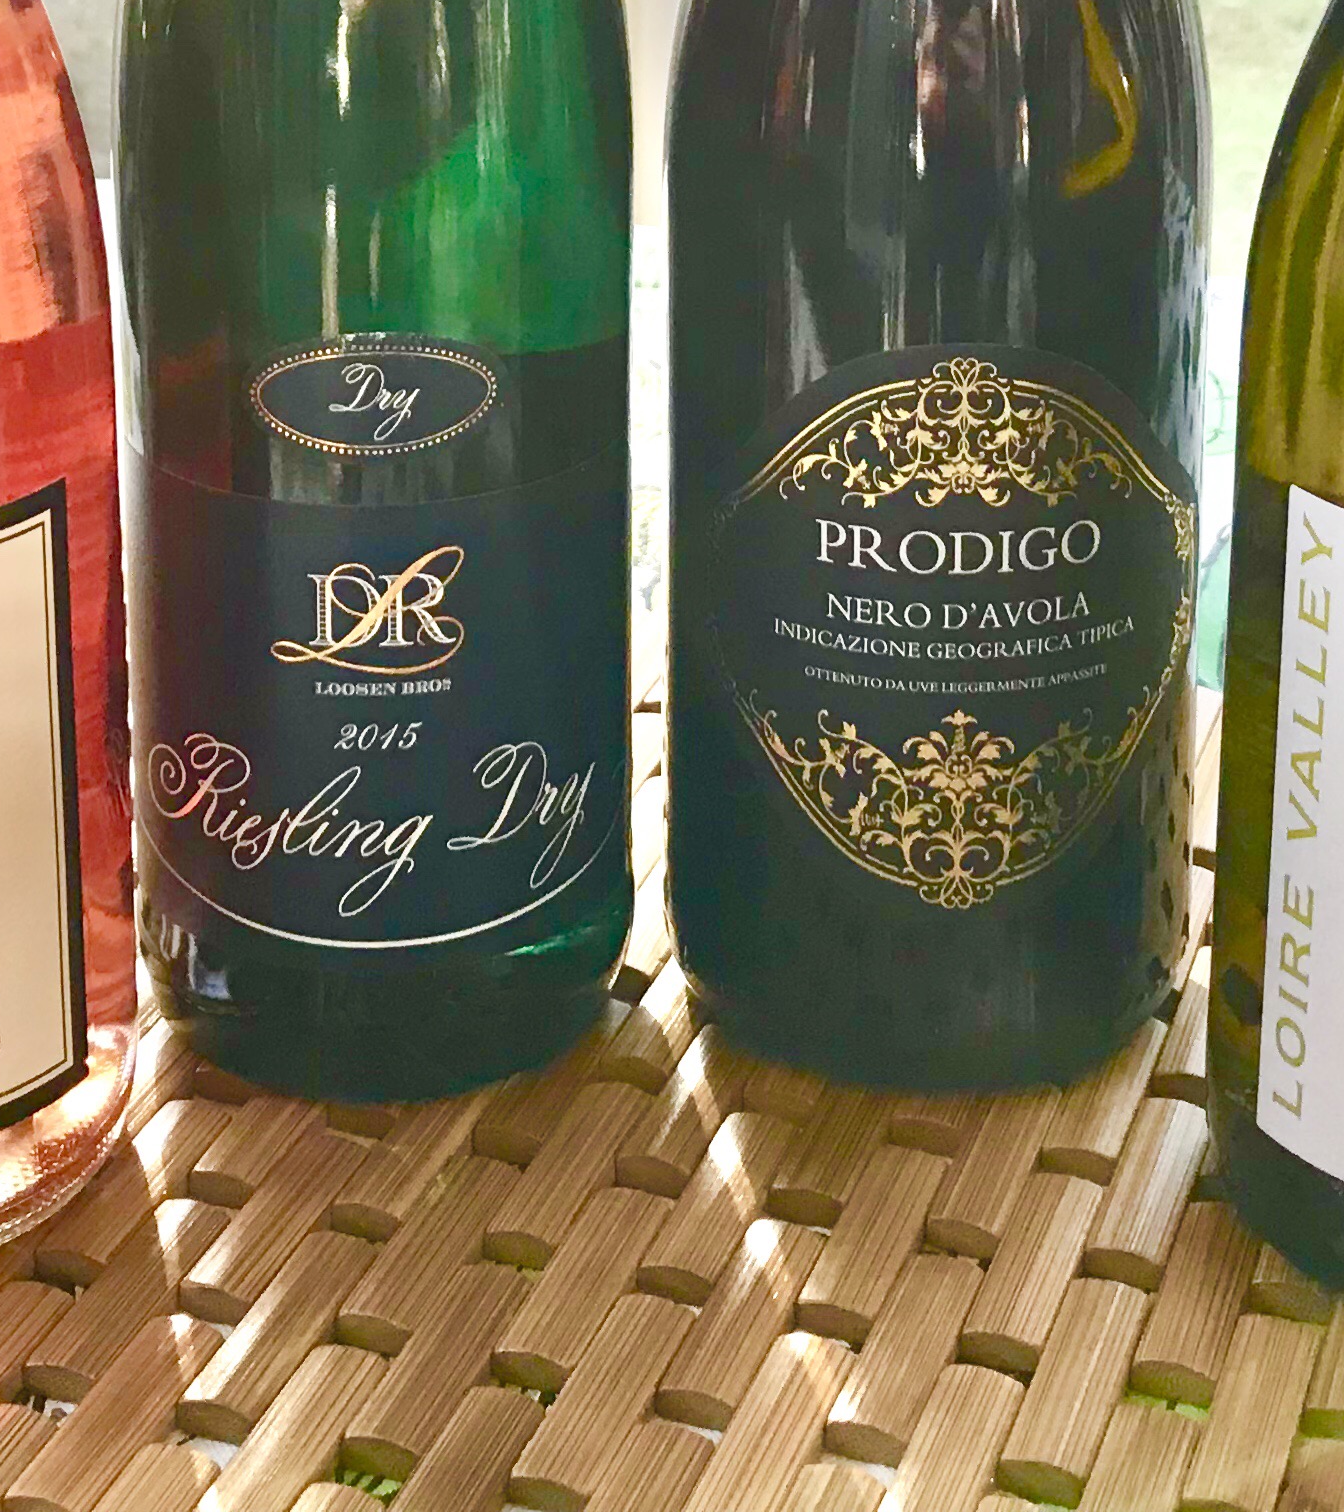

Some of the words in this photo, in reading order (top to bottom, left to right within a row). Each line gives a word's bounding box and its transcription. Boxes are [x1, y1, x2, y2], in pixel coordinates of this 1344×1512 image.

[328, 362, 421, 441] Dry
[815, 518, 1101, 576] PRODIGO
[826, 592, 931, 629] NERO
[942, 591, 1091, 630] D'AVOLA
[774, 617, 921, 659] INDICAZIONE
[926, 633, 1073, 660] GEOGRAFICA
[1077, 615, 1135, 645] TIPICA
[314, 681, 397, 697] LOOSEN
[804, 665, 883, 689] OTTENUTO
[885, 678, 906, 691] DA
[908, 680, 939, 693] UVE
[941, 676, 1045, 694] LEGGERMENTE
[1047, 663, 1108, 687] APPASSITE
[1286, 511, 1335, 842] VALLEY
[333, 721, 424, 751] 2015
[148, 732, 434, 918] Riesling
[446, 740, 596, 890] Dry
[1272, 875, 1315, 1120] LOIRE
